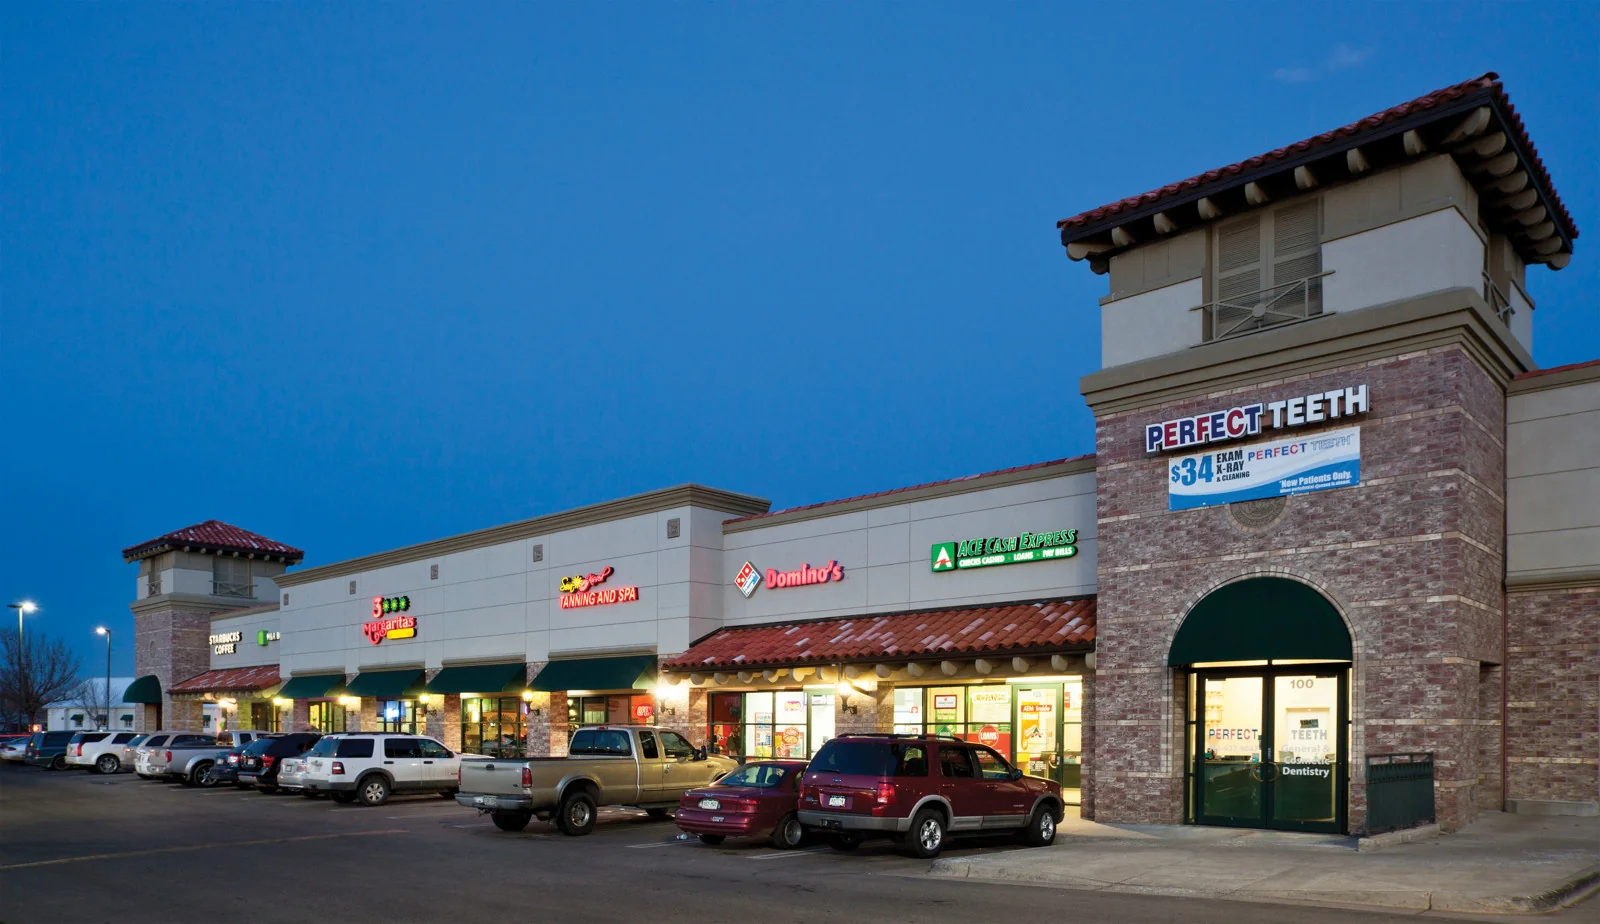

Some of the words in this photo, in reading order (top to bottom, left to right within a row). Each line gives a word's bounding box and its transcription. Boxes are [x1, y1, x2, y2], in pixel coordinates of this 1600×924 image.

[1146, 402, 1265, 453] PERFECT
[1268, 384, 1370, 428] TEETH
[1248, 443, 1307, 461] PERFECT
[1311, 435, 1351, 450] TEETH
[1217, 450, 1243, 463] EXAM
[1171, 455, 1214, 486] $34
[1217, 460, 1244, 474] X-RAY
[1222, 470, 1250, 481] CLEANING
[1299, 474, 1331, 486] Patients
[957, 538, 984, 557] ACE
[986, 536, 1017, 553] CASH
[1020, 529, 1076, 549] EXPRESS
[959, 557, 981, 567] CHECKS
[982, 555, 1005, 565] CASHED
[1013, 552, 1033, 561] LOANS
[1042, 549, 1055, 557] PAY
[1055, 547, 1072, 556] BILLS
[766, 560, 844, 589] Domino's
[560, 591, 596, 608] TANNING
[597, 589, 616, 604] AND
[618, 587, 636, 602] SPA
[372, 596, 382, 618] 3
[363, 616, 415, 644] Margaritas
[209, 631, 240, 645] STARBUCKS
[214, 643, 234, 655] COFFEE
[1290, 679, 1314, 689] 100
[1209, 729, 1258, 740] PERFECT
[1291, 729, 1327, 740] TEETH
[1281, 744, 1321, 753] General
[1284, 756, 1330, 765] Cosmetic
[1282, 766, 1330, 778] Dentistry
